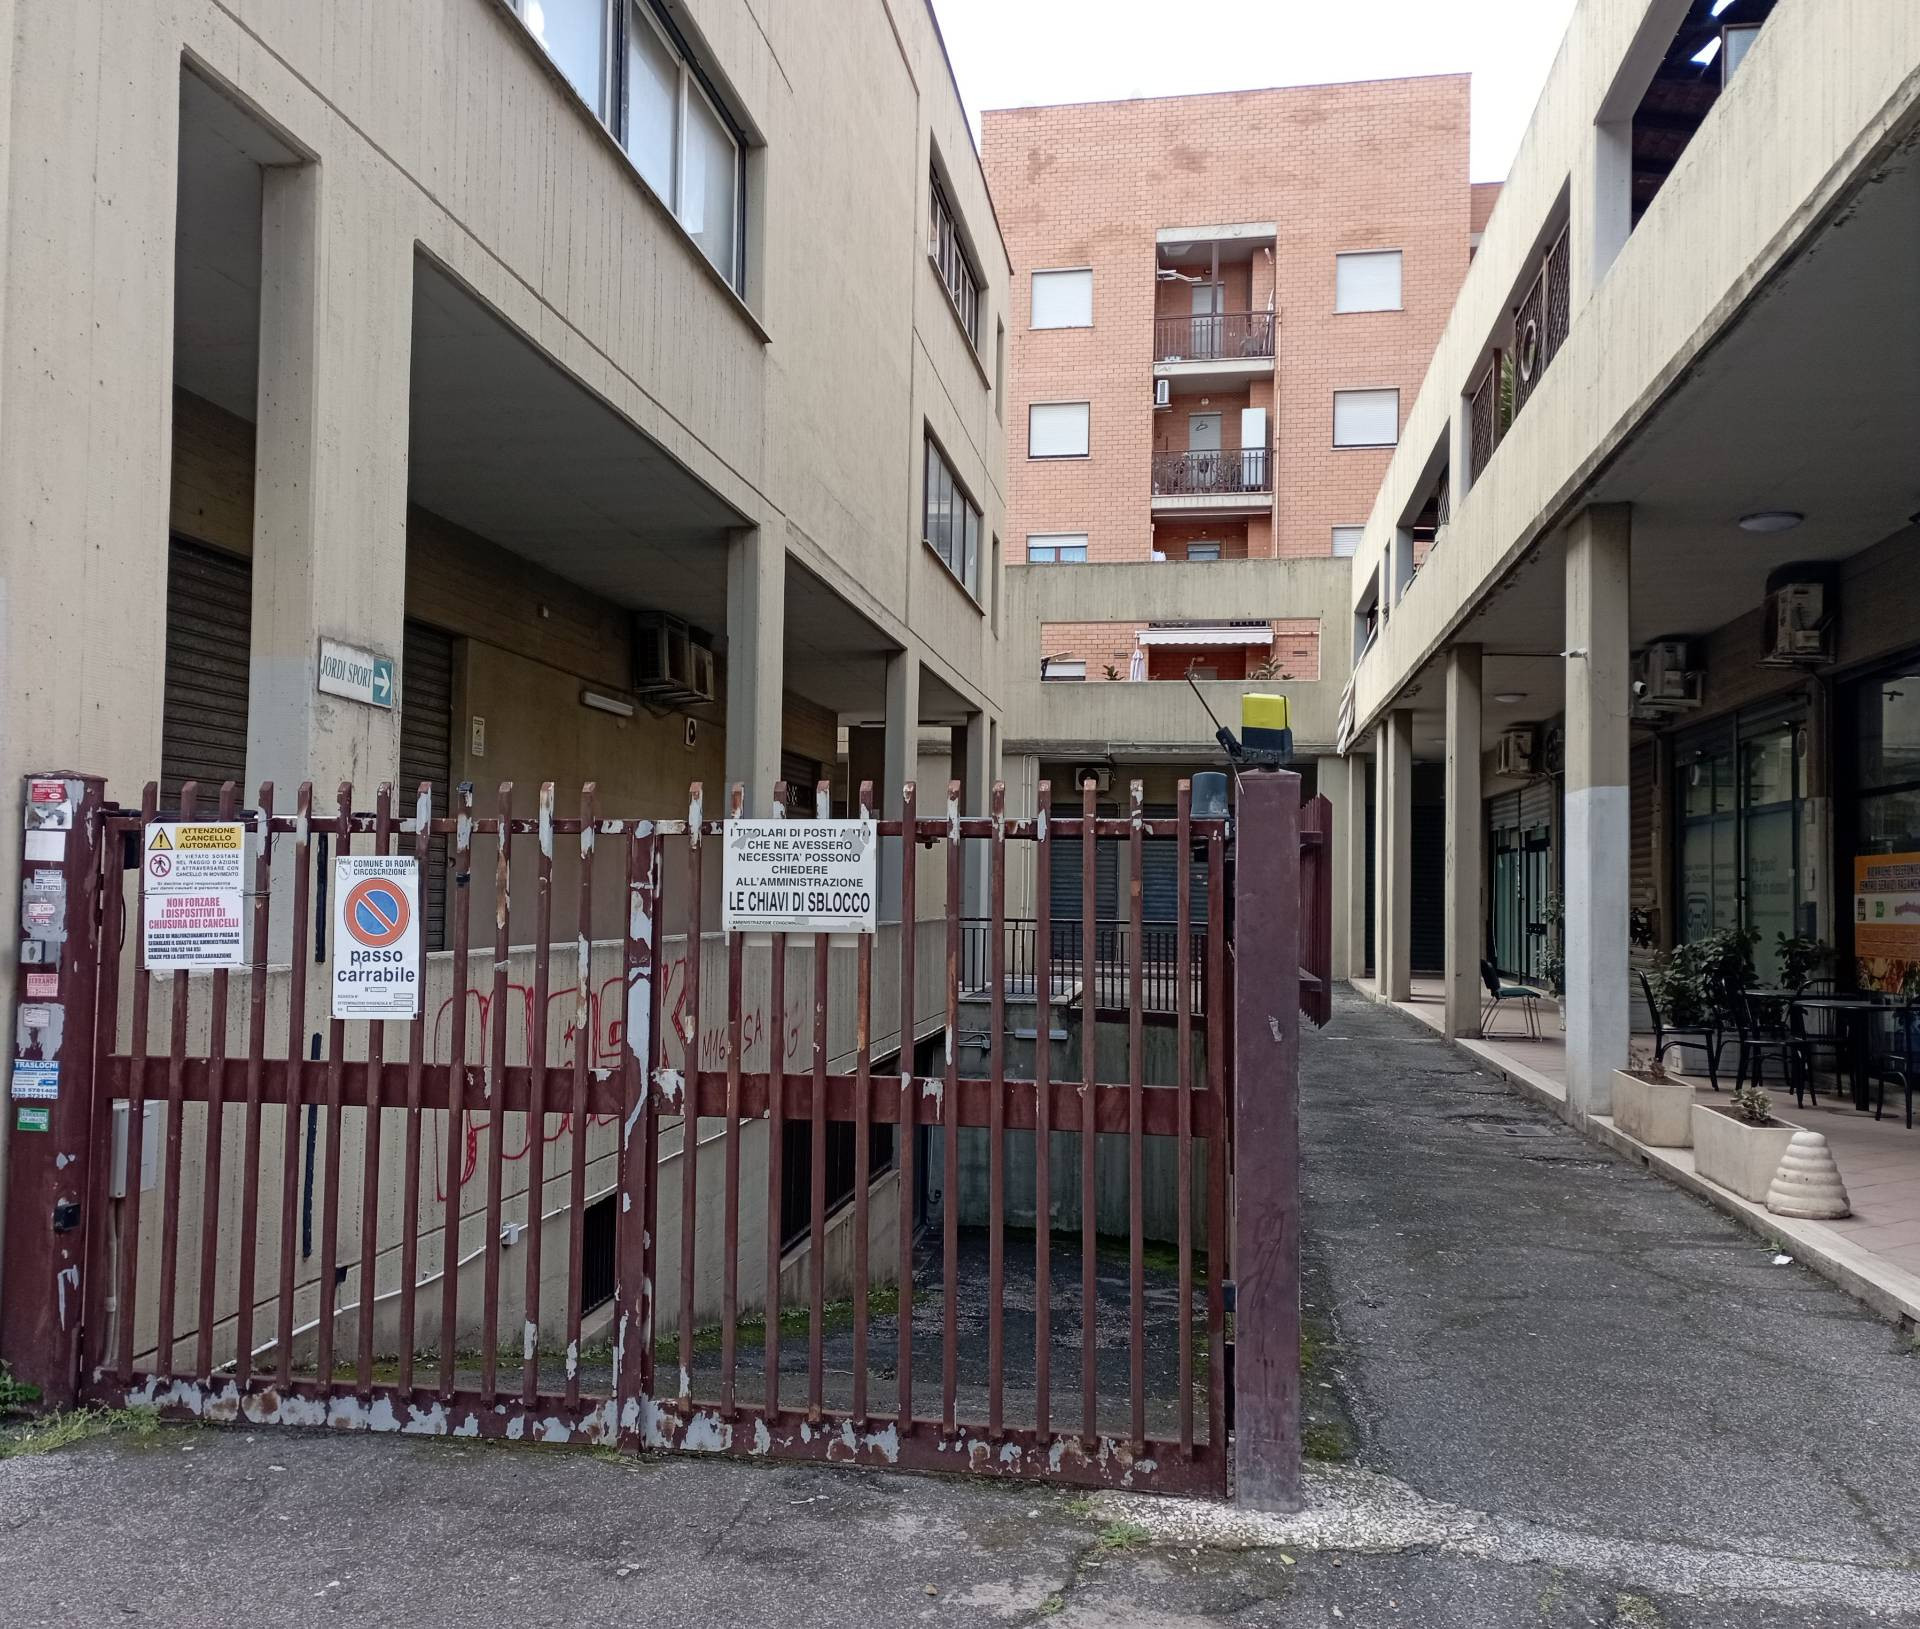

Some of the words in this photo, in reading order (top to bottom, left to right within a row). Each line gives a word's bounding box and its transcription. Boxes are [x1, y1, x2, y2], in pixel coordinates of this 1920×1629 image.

[320, 655, 347, 681] JORDI
[347, 663, 373, 689] SPORT
[730, 829, 734, 837] I
[736, 828, 787, 837] TITOLARI
[789, 829, 801, 837] DI
[803, 829, 837, 837] POSTI
[185, 834, 232, 842] CANCELLO
[747, 840, 771, 850] CHE
[774, 841, 788, 850] NE
[792, 841, 853, 850] AVESSERO
[738, 852, 802, 862] NECESSITA'
[804, 853, 861, 863] POSSONO
[353, 859, 384, 868] COMUNE
[385, 859, 393, 868] DI
[394, 859, 416, 868] ROMA
[353, 868, 407, 876] CIRCOSCRIZIONE
[771, 865, 828, 875] CHIEDERE
[735, 877, 864, 888] ALL'AMMINISTRAZIONE
[166, 898, 184, 907] NON
[185, 897, 220, 907] FORZARE
[729, 891, 745, 911] LE
[748, 891, 789, 912] CHIAVI
[792, 892, 804, 912] DI
[807, 892, 871, 913] SBLOCCO
[161, 909, 165, 918] I
[166, 908, 215, 918] DISPOSITIVI
[216, 908, 226, 917] DI
[148, 919, 188, 930] CHIUSURA
[189, 919, 201, 929] DEI
[202, 918, 239, 928] CANCELLI
[350, 950, 403, 966] passo
[337, 967, 416, 983] carrabile
[15, 1061, 59, 1069] TRASLOCHI
